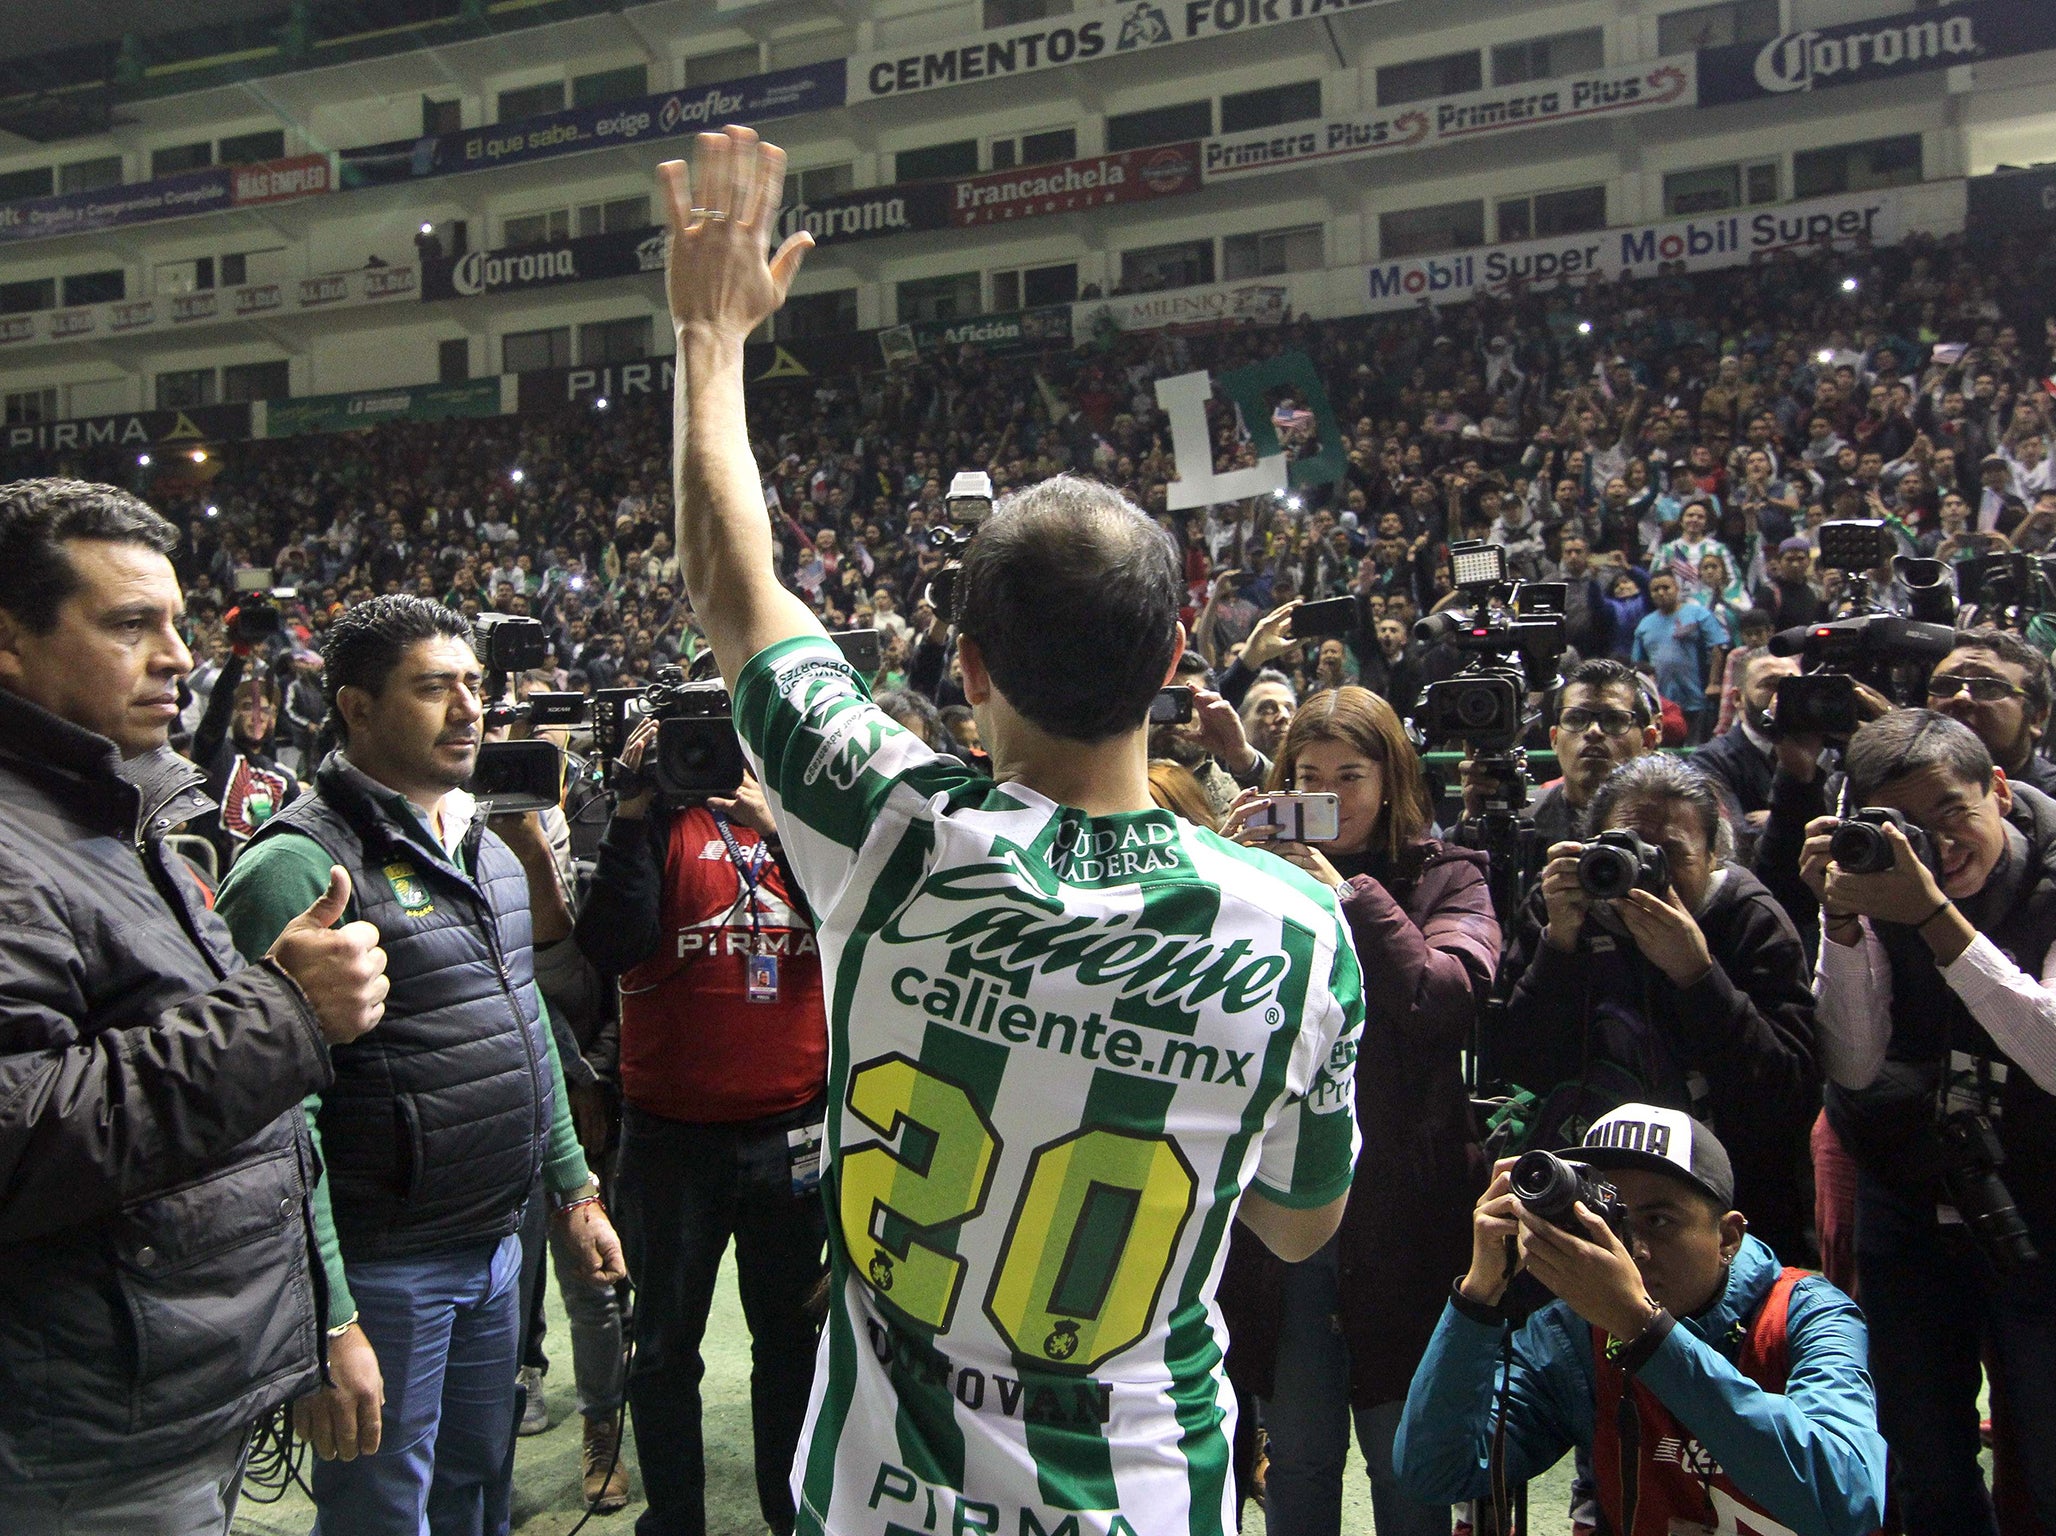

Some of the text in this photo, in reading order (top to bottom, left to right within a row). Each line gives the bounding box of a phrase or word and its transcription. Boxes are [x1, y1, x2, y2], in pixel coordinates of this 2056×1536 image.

[868, 0, 1378, 95] CEMENTOS FOR
[1754, 16, 1976, 92] Corona
[465, 139, 485, 161] El
[486, 135, 523, 165] que
[596, 111, 650, 138] exige
[681, 91, 744, 123] coflex
[1437, 74, 1642, 132] Primera Plus
[1206, 133, 1317, 170] Primera
[1327, 118, 1391, 150] Plus
[956, 161, 1125, 209] Francachela
[772, 199, 907, 248] Corona
[1620, 205, 1880, 265] Mobil Super
[452, 248, 575, 297] Corona
[1369, 244, 1598, 299] Mobil Super
[1131, 293, 1227, 319] MILENIO
[944, 320, 1020, 344] Afición
[567, 361, 675, 402] PIR
[10, 417, 148, 450] PIRMA
[779, 659, 851, 683] DEPORTES
[1042, 845, 1180, 883] MADERAS
[677, 932, 818, 958] PIRMA
[879, 863, 1291, 1016] Caliente
[890, 966, 1256, 1087] caliente.mx
[839, 1051, 1199, 1374] 20
